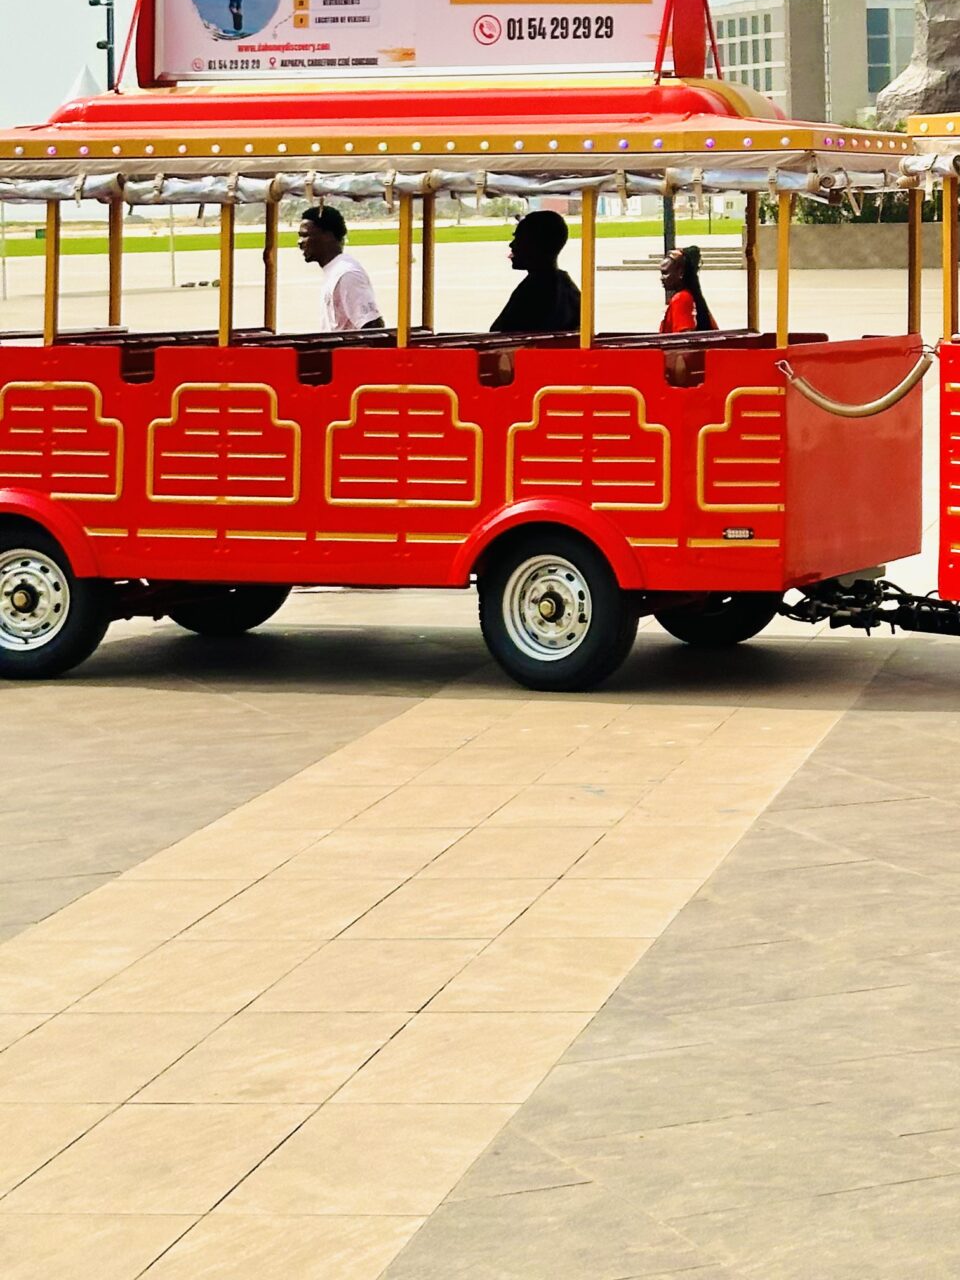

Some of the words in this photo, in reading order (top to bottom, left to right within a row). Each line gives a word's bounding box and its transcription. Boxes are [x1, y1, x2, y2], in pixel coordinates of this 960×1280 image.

[507, 18, 524, 41] 01
[527, 17, 547, 40] 54
[550, 16, 569, 40] 29
[572, 16, 592, 39] 29
[595, 16, 614, 39] 29
